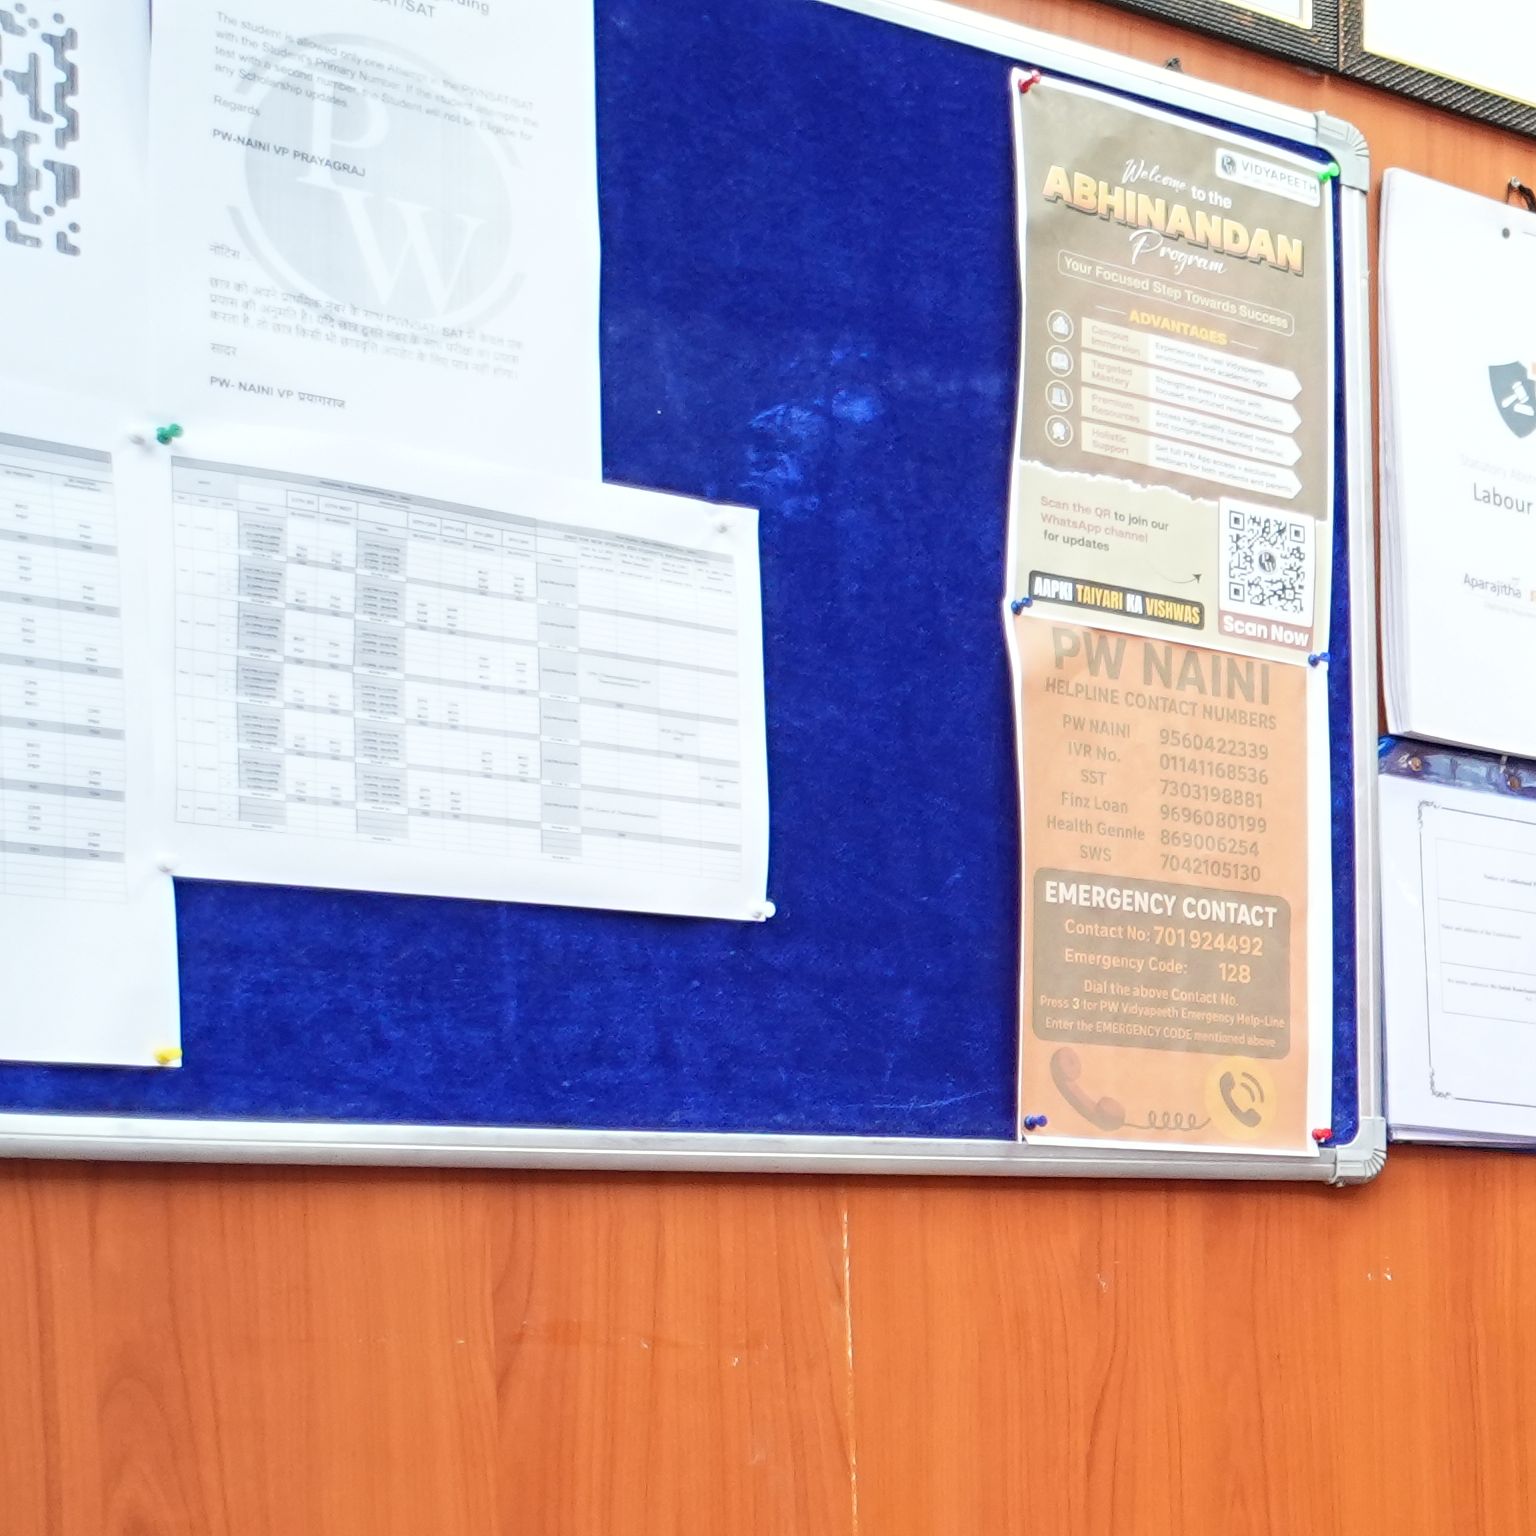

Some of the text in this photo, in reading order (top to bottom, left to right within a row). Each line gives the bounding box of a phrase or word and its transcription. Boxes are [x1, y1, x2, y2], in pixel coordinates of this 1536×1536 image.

[216, 11, 282, 39] The student
[242, 37, 258, 49] the
[214, 95, 261, 117] Regards
[212, 128, 366, 177] PW-NAINI VP PRAYAGRAJ
[1121, 159, 1233, 210] Welcome to the
[1241, 161, 1319, 193] VIDYAPEETH
[1042, 165, 1305, 279] ABHINANDAN
[1128, 229, 1228, 276] Program
[1064, 256, 1289, 330] Your Focused Step Towards Success
[1129, 309, 1229, 346] ADVANTAGES
[210, 376, 235, 388] PW-
[238, 381, 274, 396] NAINI
[277, 388, 294, 400] VP
[1041, 496, 1169, 531] Scan the QR to join our
[1473, 482, 1533, 515] Labour
[1041, 513, 1149, 544] WhatsApp channel
[1044, 530, 1110, 552] for updates
[1033, 576, 1200, 625] AAPKI TAIYARI KA VISHWAS
[1463, 572, 1521, 599] Aparajitha
[1222, 615, 1309, 648] Scan Now
[1052, 626, 1271, 706] PW NAINI
[1045, 677, 1278, 730] HELPLINE CONTACT NUMBERS
[1062, 713, 1269, 760] PW NAINI 9560422339
[1068, 741, 1092, 758] IVR
[1096, 747, 1121, 763] No.
[1080, 768, 1107, 786] SST
[1061, 791, 1090, 809] Finz
[1094, 795, 1129, 814] Loan
[1046, 815, 1093, 834] Health
[1079, 844, 1112, 862] SWS
[1045, 880, 1278, 929] EMERGENCY CONTACT
[1064, 919, 1124, 939] Contact
[1127, 925, 1151, 942] No:
[1064, 948, 1252, 984] Emergency Code: 128
[1084, 979, 1239, 1007] Dial the above Contact No.
[1040, 995, 1069, 1009] Press
[1071, 997, 1080, 1010] 3
[1082, 998, 1099, 1011] for
[1100, 1000, 1119, 1013] PW
[1121, 1001, 1179, 1019] Vidyapeeth
[1181, 1007, 1235, 1026] Emergency
[1045, 1016, 1075, 1031] Enter
[1077, 1019, 1094, 1033] the
[1096, 1020, 1160, 1038] EMERGENCY
[1163, 1026, 1193, 1041] CODE
[1194, 1030, 1245, 1045] mentioned
